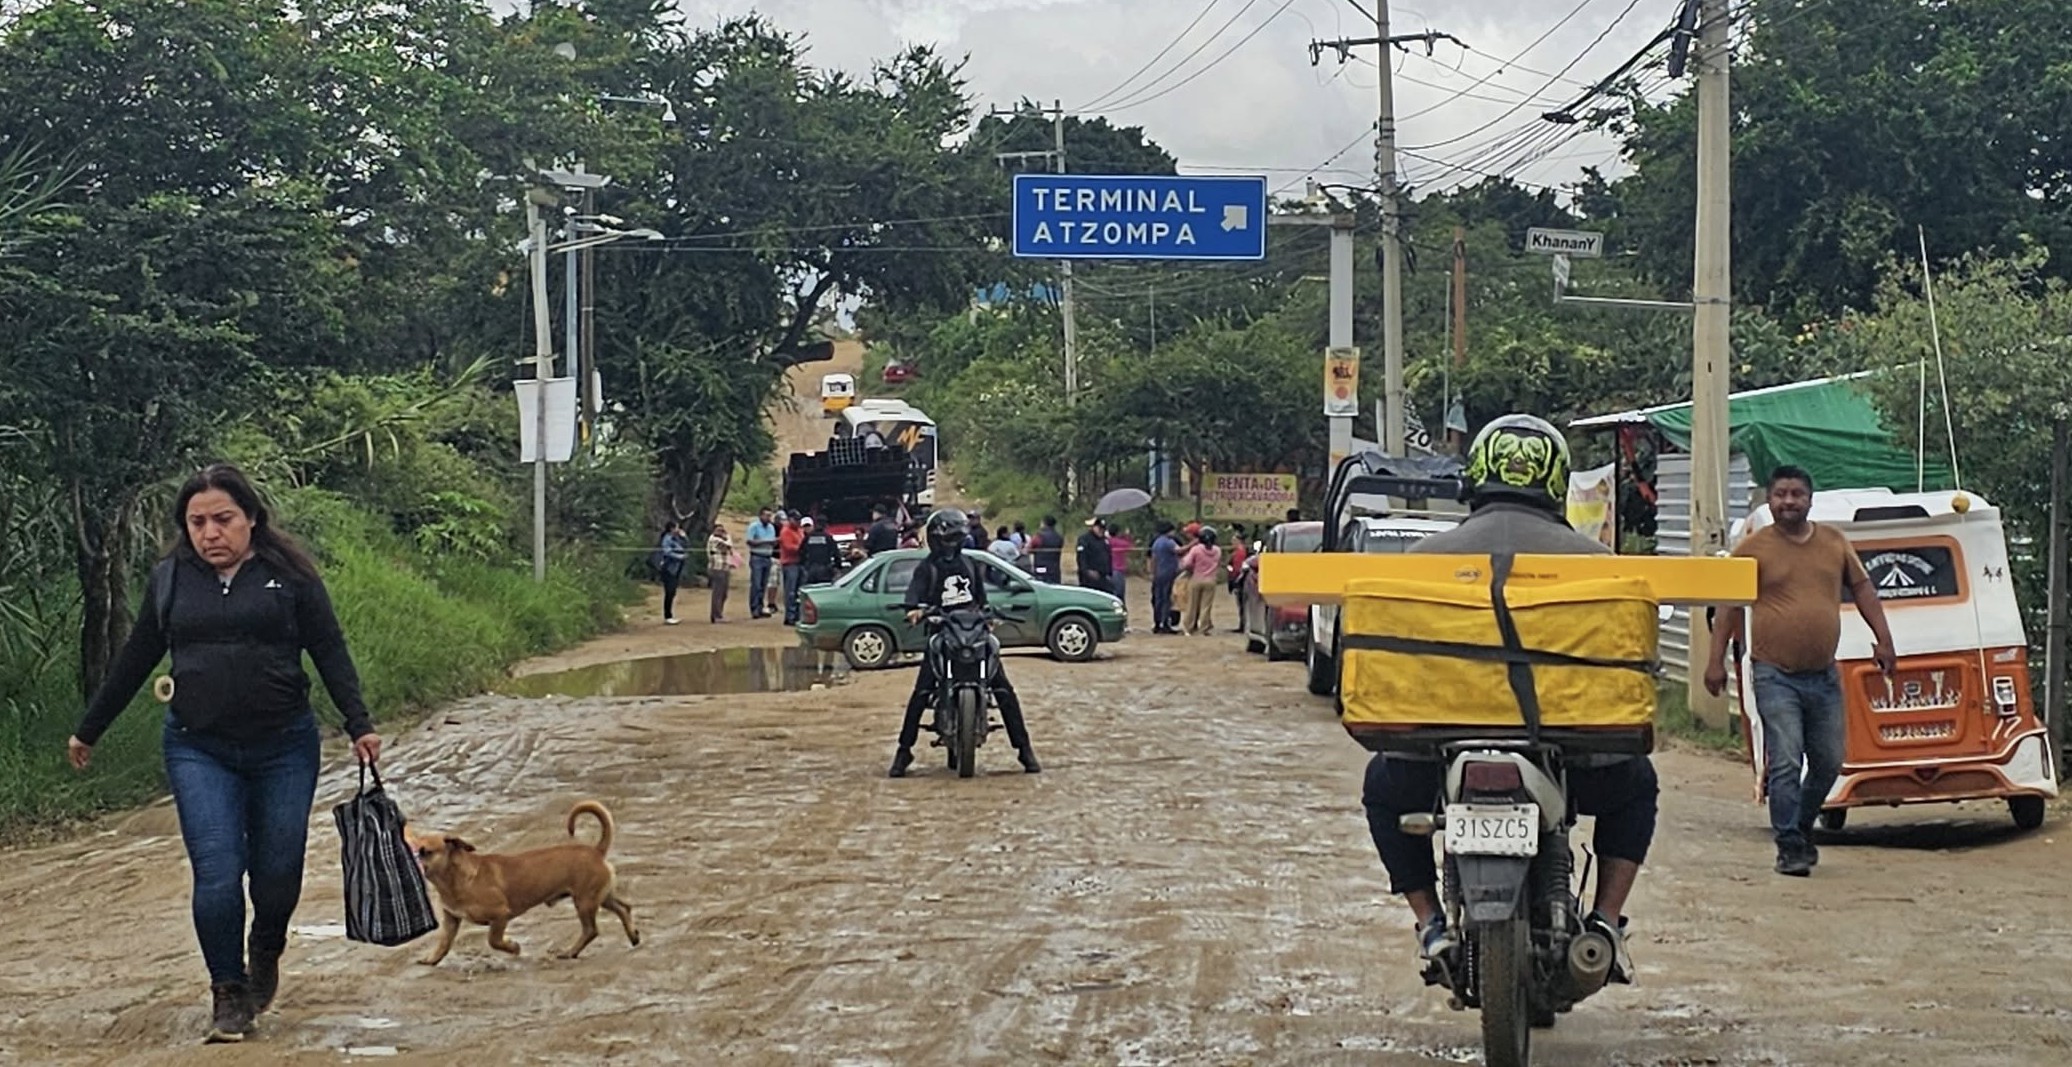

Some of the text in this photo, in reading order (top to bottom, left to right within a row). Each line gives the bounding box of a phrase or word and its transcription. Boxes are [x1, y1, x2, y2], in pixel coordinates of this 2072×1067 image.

[1032, 188, 1206, 213] TERMINAL
[1032, 221, 1197, 245] ATZOMPA
[1532, 233, 1596, 250] KhananY
[1218, 476, 1280, 490] RENTA DE
[1991, 716, 2023, 741] 17
[1455, 818, 1529, 839] 31SZC5
